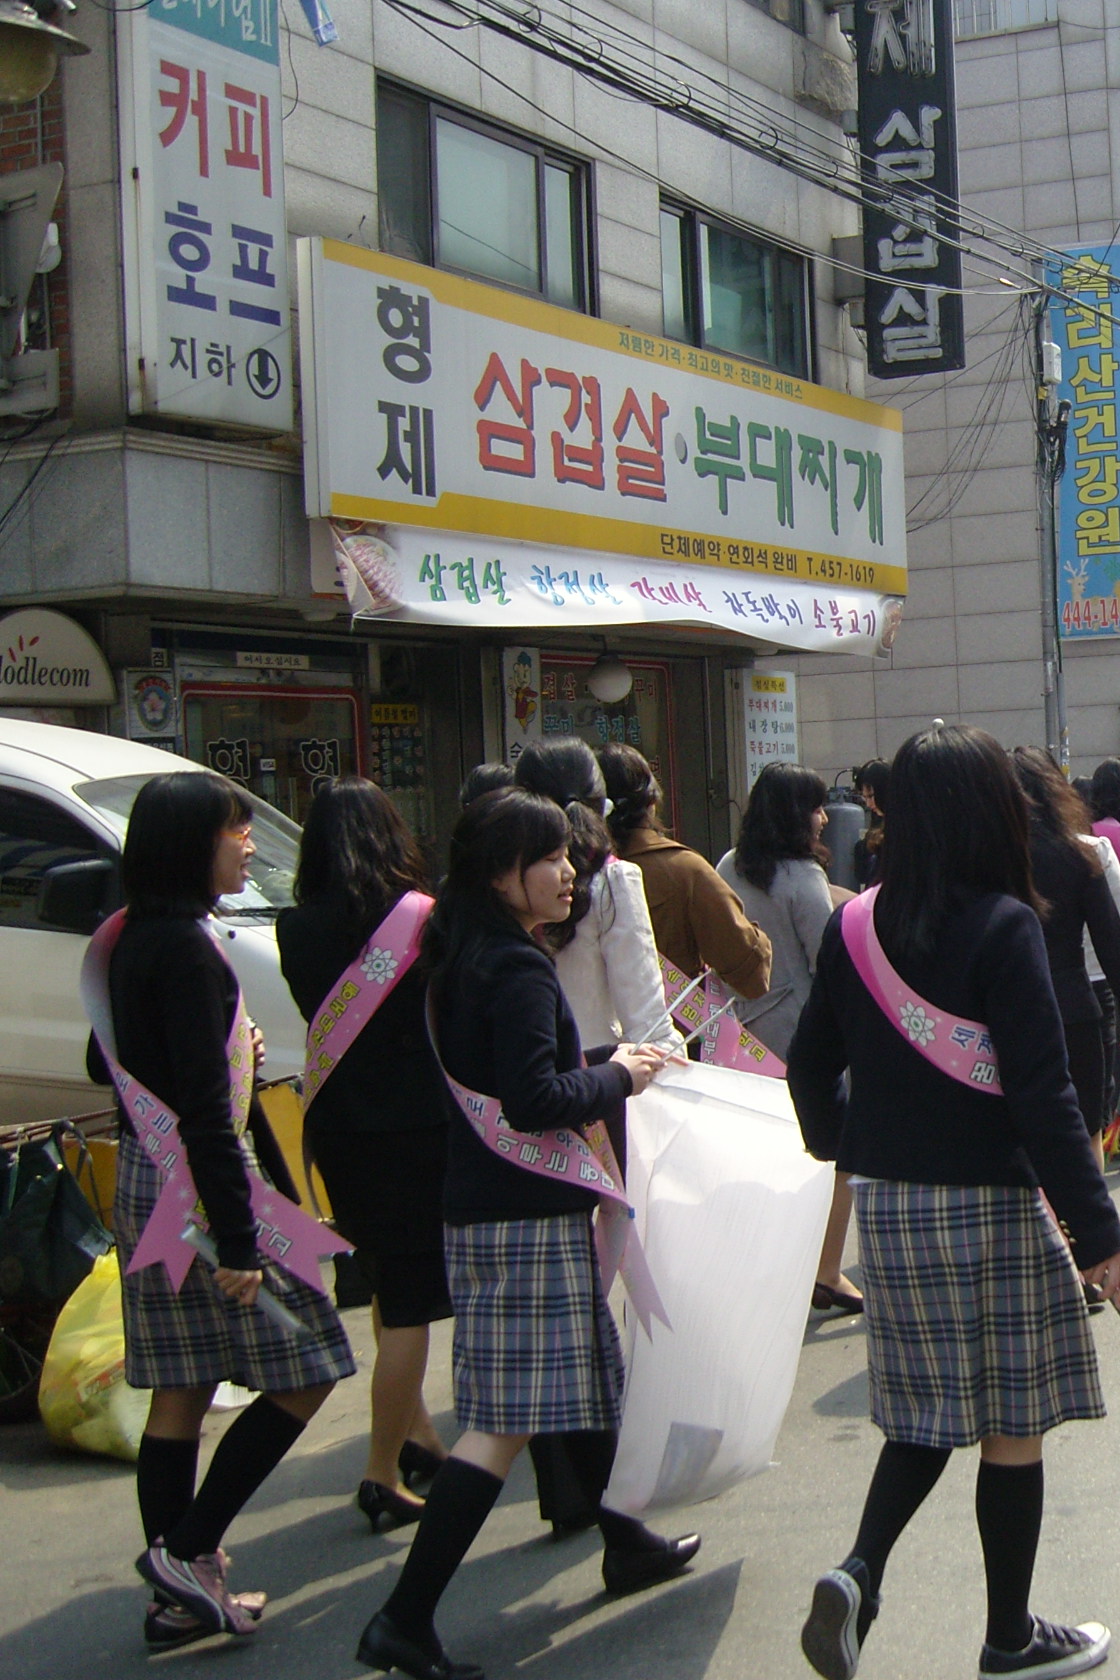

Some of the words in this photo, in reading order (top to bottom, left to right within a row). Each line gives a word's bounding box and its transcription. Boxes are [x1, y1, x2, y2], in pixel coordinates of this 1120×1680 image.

[158, 58, 273, 199] 커피
[164, 200, 282, 327] 호프
[873, 104, 946, 364] 삼겹살
[169, 336, 237, 386] 지하
[375, 284, 438, 500] 형제
[618, 331, 656, 357] 저렴한
[658, 343, 681, 365] 가격
[687, 351, 721, 374] 최고의
[723, 362, 734, 379] 맛
[740, 367, 773, 391] 친절한
[775, 381, 804, 400] 서비스
[472, 350, 670, 503] 삼겹살
[693, 403, 886, 547] 부대찌개
[418, 553, 512, 606] 삼겹살
[530, 564, 623, 607] 항정살
[722, 590, 804, 627] 차돌박이
[812, 597, 877, 637] 소불고기
[660, 532, 722, 562] 단체예약
[727, 543, 769, 569] 연회석
[772, 550, 798, 573] 완비
